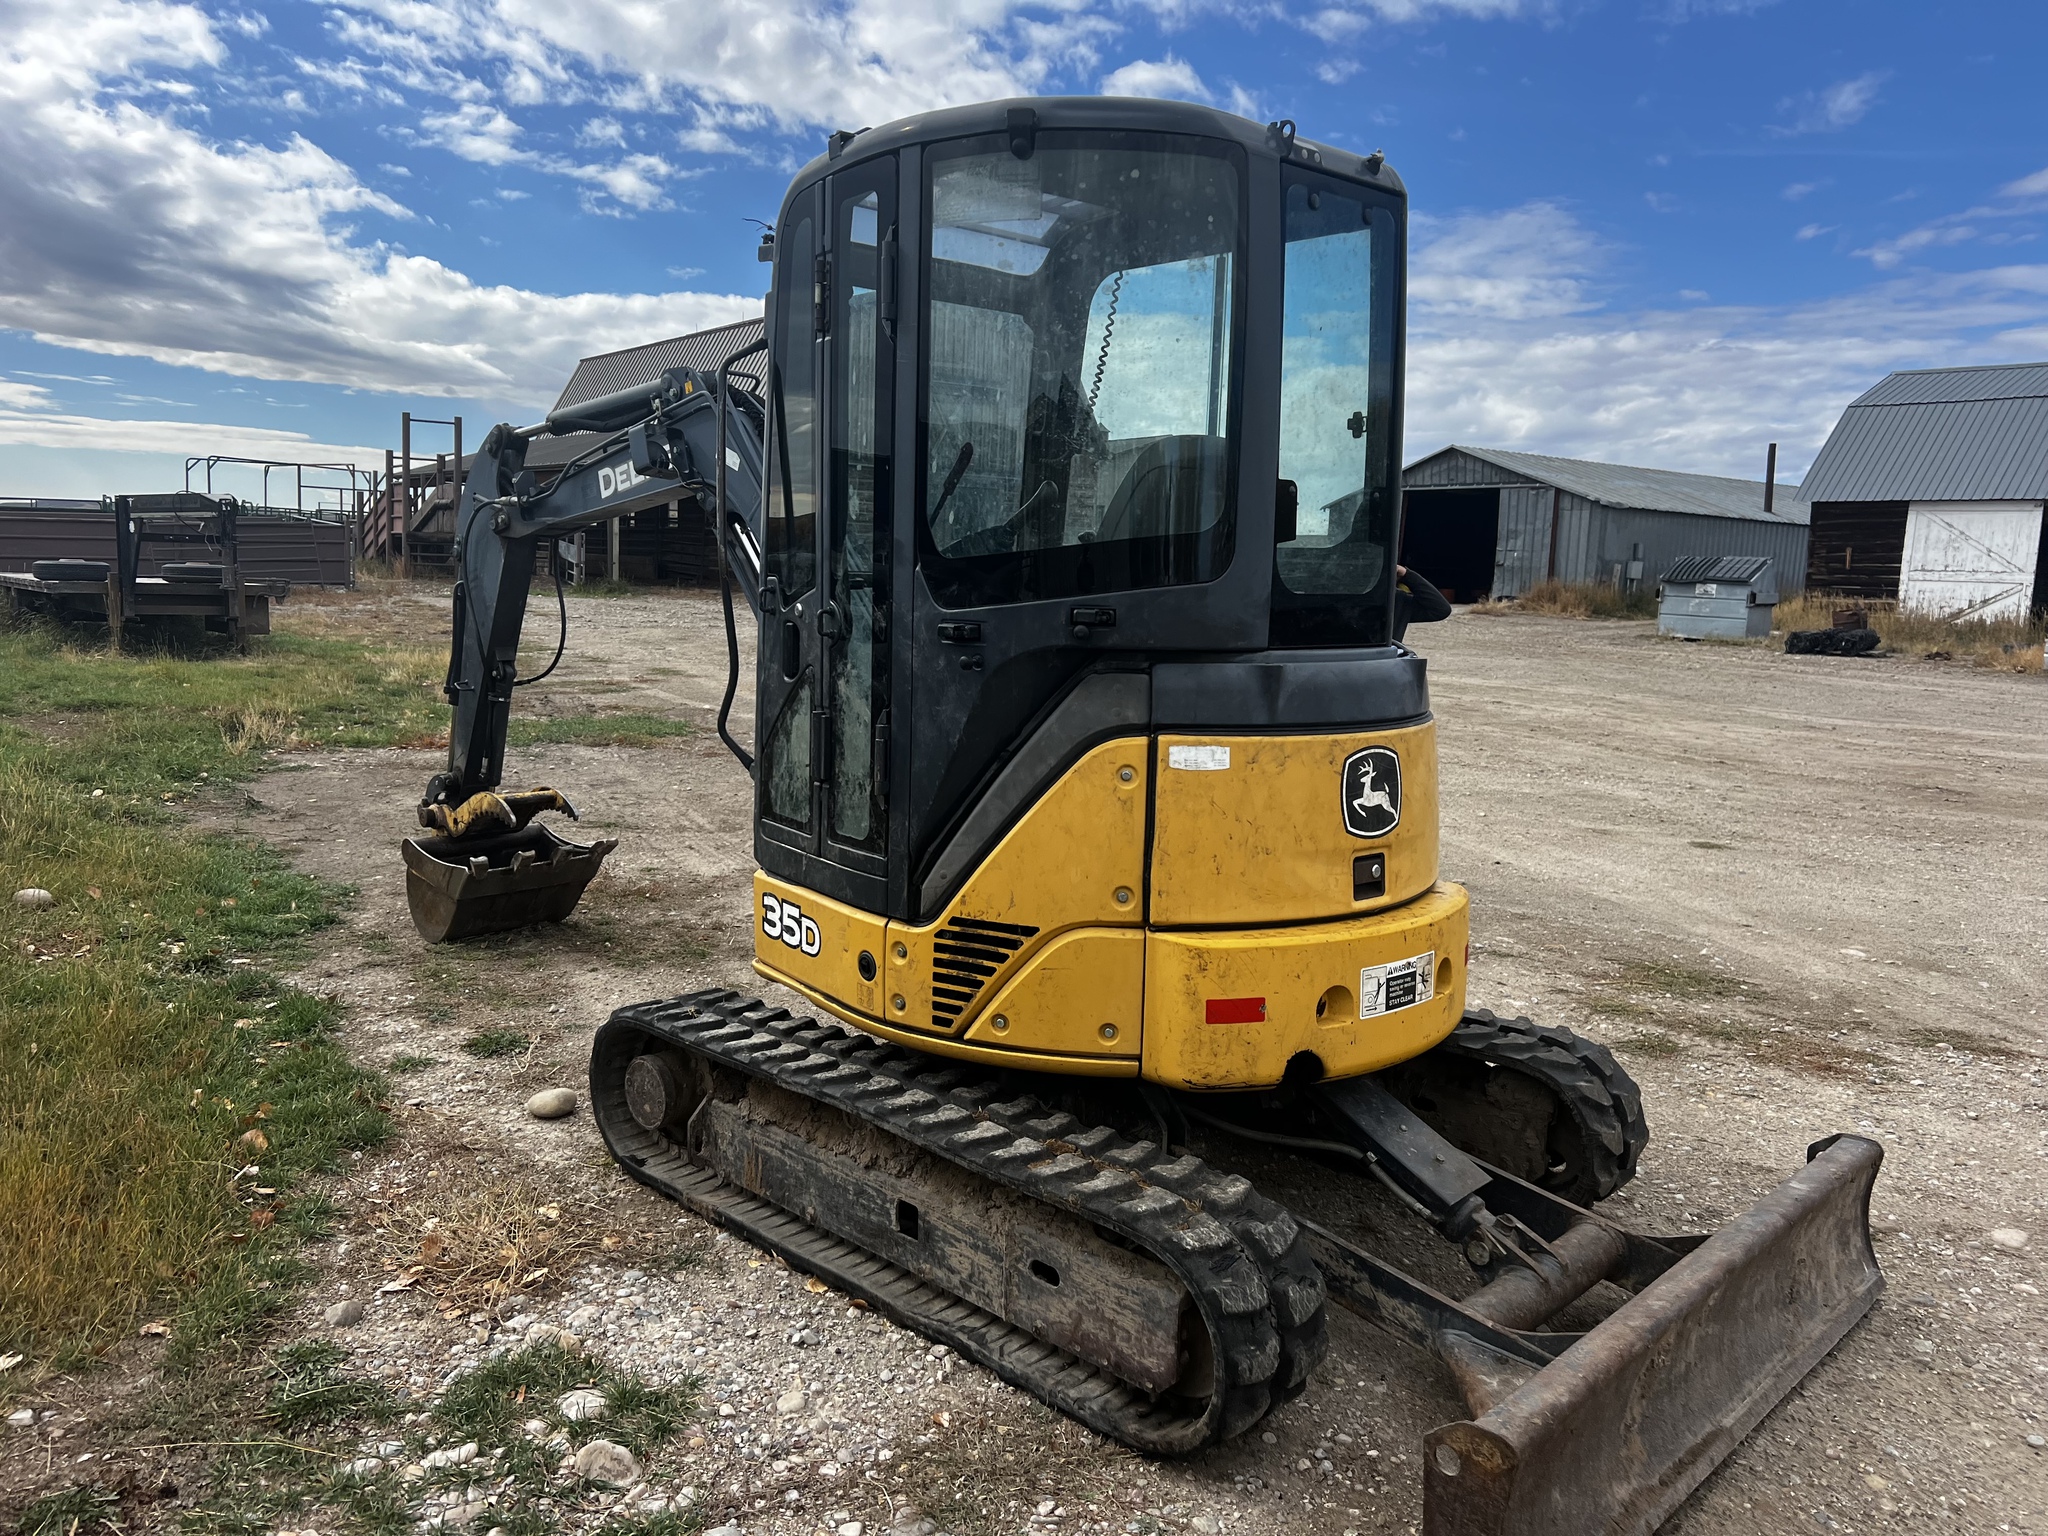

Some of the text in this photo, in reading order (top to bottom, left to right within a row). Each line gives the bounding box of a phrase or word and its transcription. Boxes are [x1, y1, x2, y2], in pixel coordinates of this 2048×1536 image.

[762, 892, 821, 957] 35D
[1389, 994, 1413, 1006] STAY CLEAR
